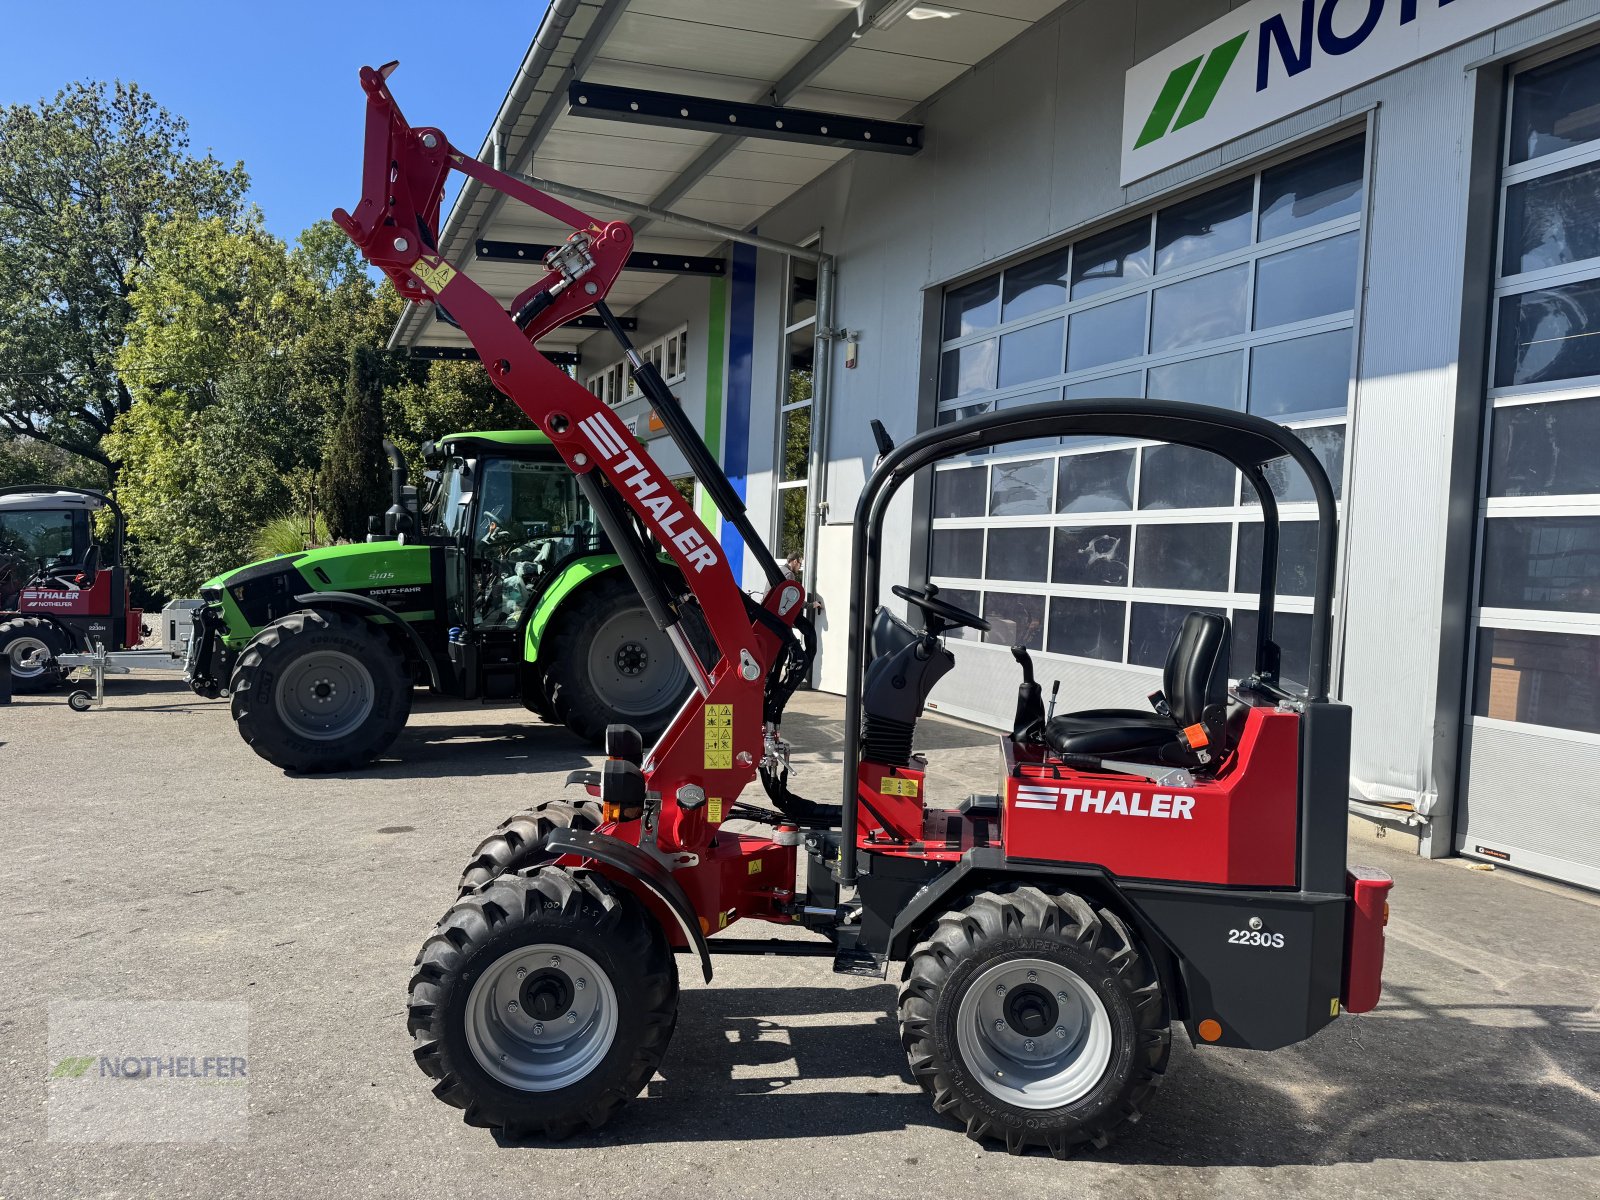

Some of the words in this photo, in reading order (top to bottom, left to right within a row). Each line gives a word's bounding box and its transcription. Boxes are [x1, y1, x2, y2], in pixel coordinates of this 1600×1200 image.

[1256, 0, 1454, 93] NO
[613, 449, 718, 574] THALER
[369, 586, 421, 596] DEUTZ-FAHR
[1060, 787, 1196, 820] THALER
[1228, 929, 1285, 948] 2230S
